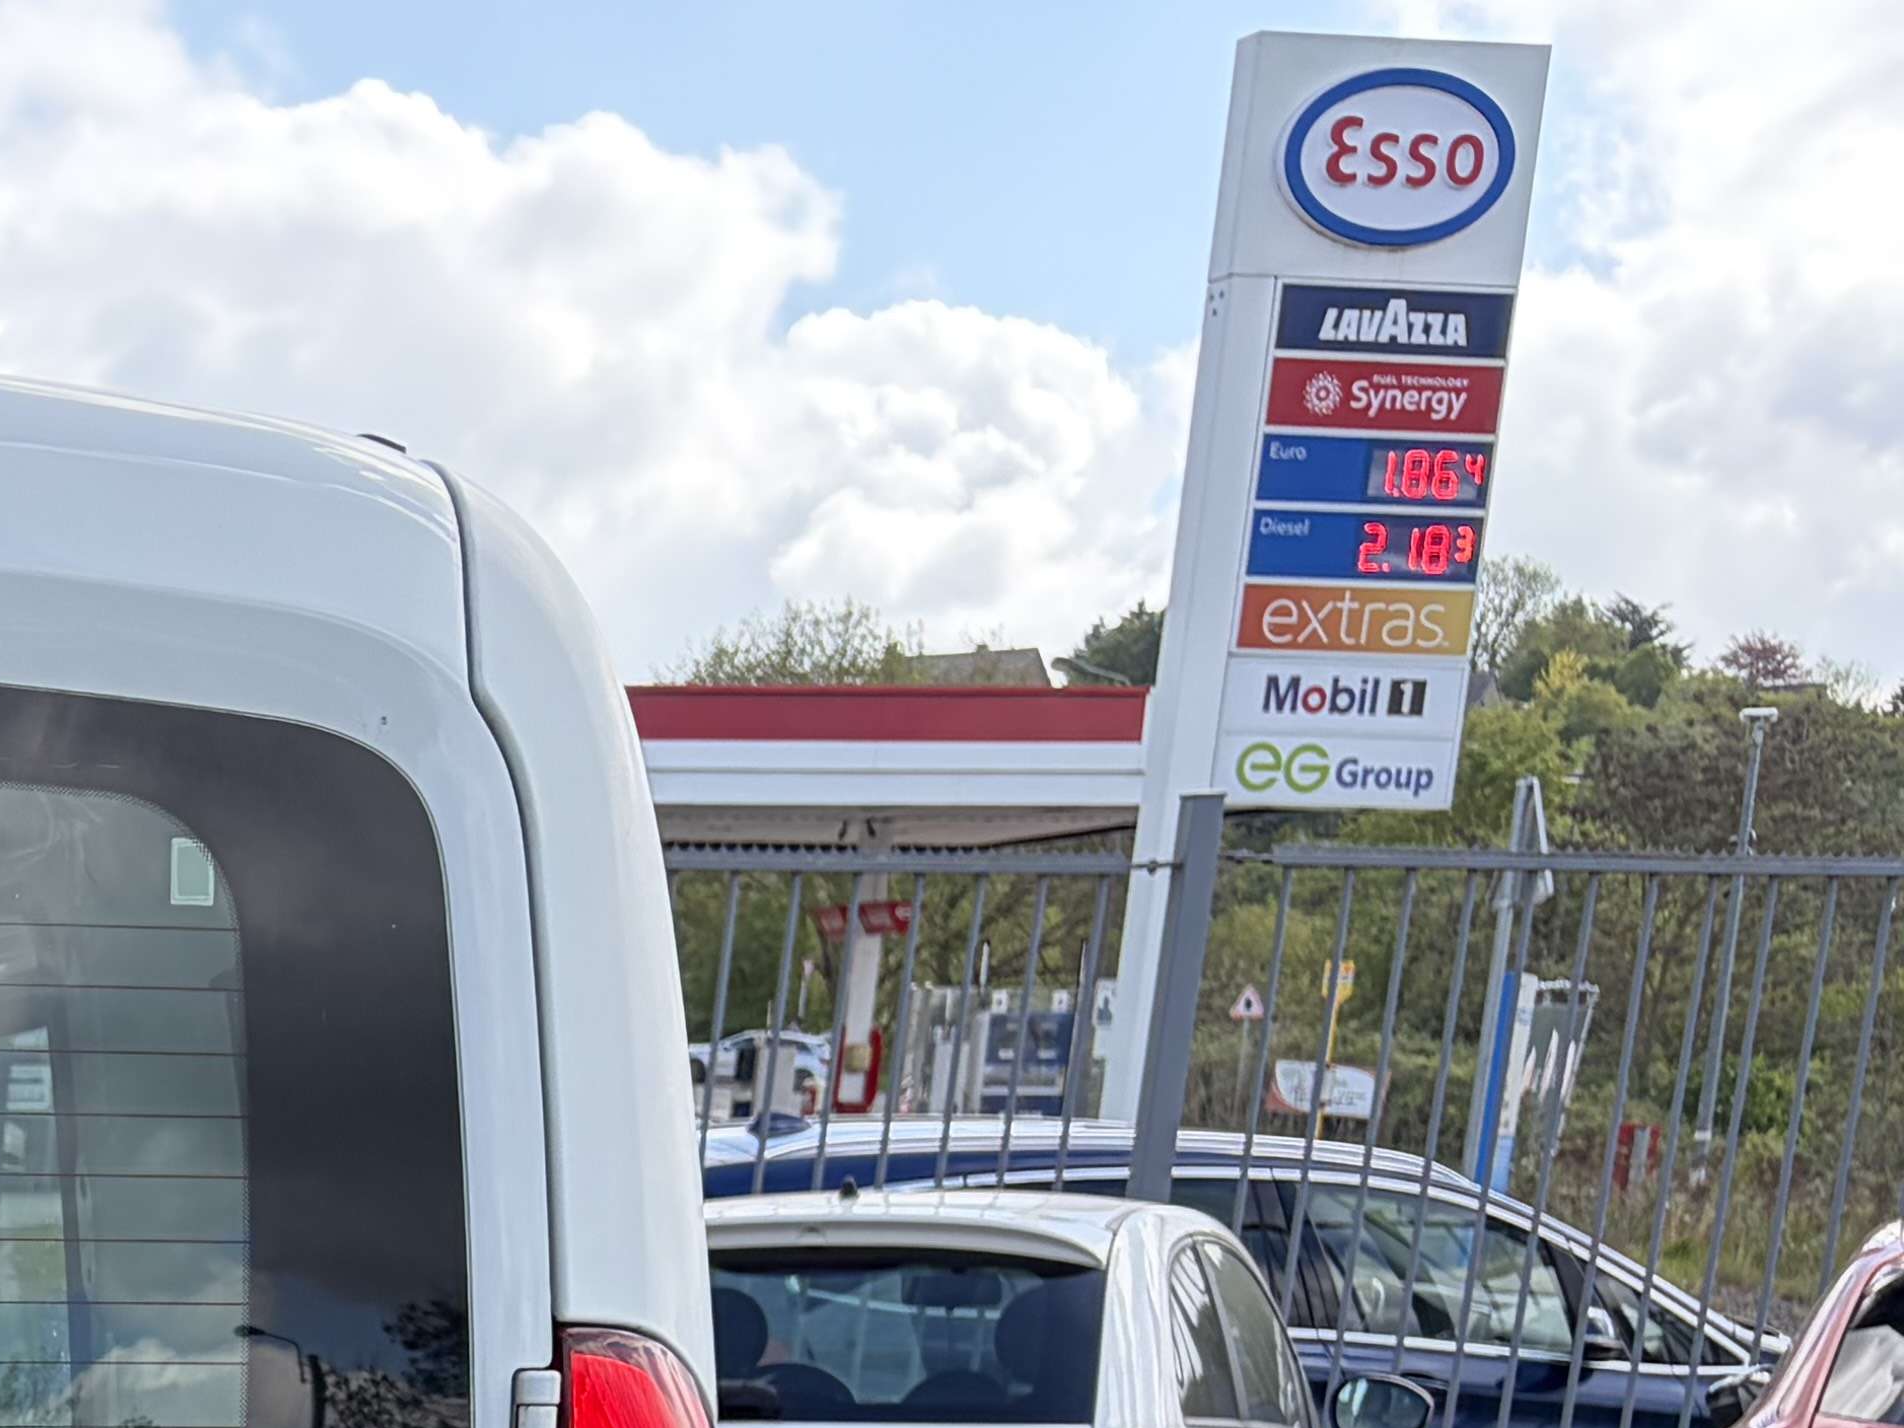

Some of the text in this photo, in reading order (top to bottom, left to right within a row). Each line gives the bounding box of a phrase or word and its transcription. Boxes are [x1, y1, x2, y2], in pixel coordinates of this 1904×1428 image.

[1318, 298, 1468, 347] LAVAZZA
[1349, 379, 1468, 421] Synergy
[1372, 373, 1470, 388] FUEL TECHNOLOGY
[1269, 442, 1307, 461] Euro
[1259, 517, 1310, 537] Diesel
[1261, 590, 1446, 648] extras
[1261, 674, 1380, 716] Mobil
[1335, 757, 1434, 795] Group
